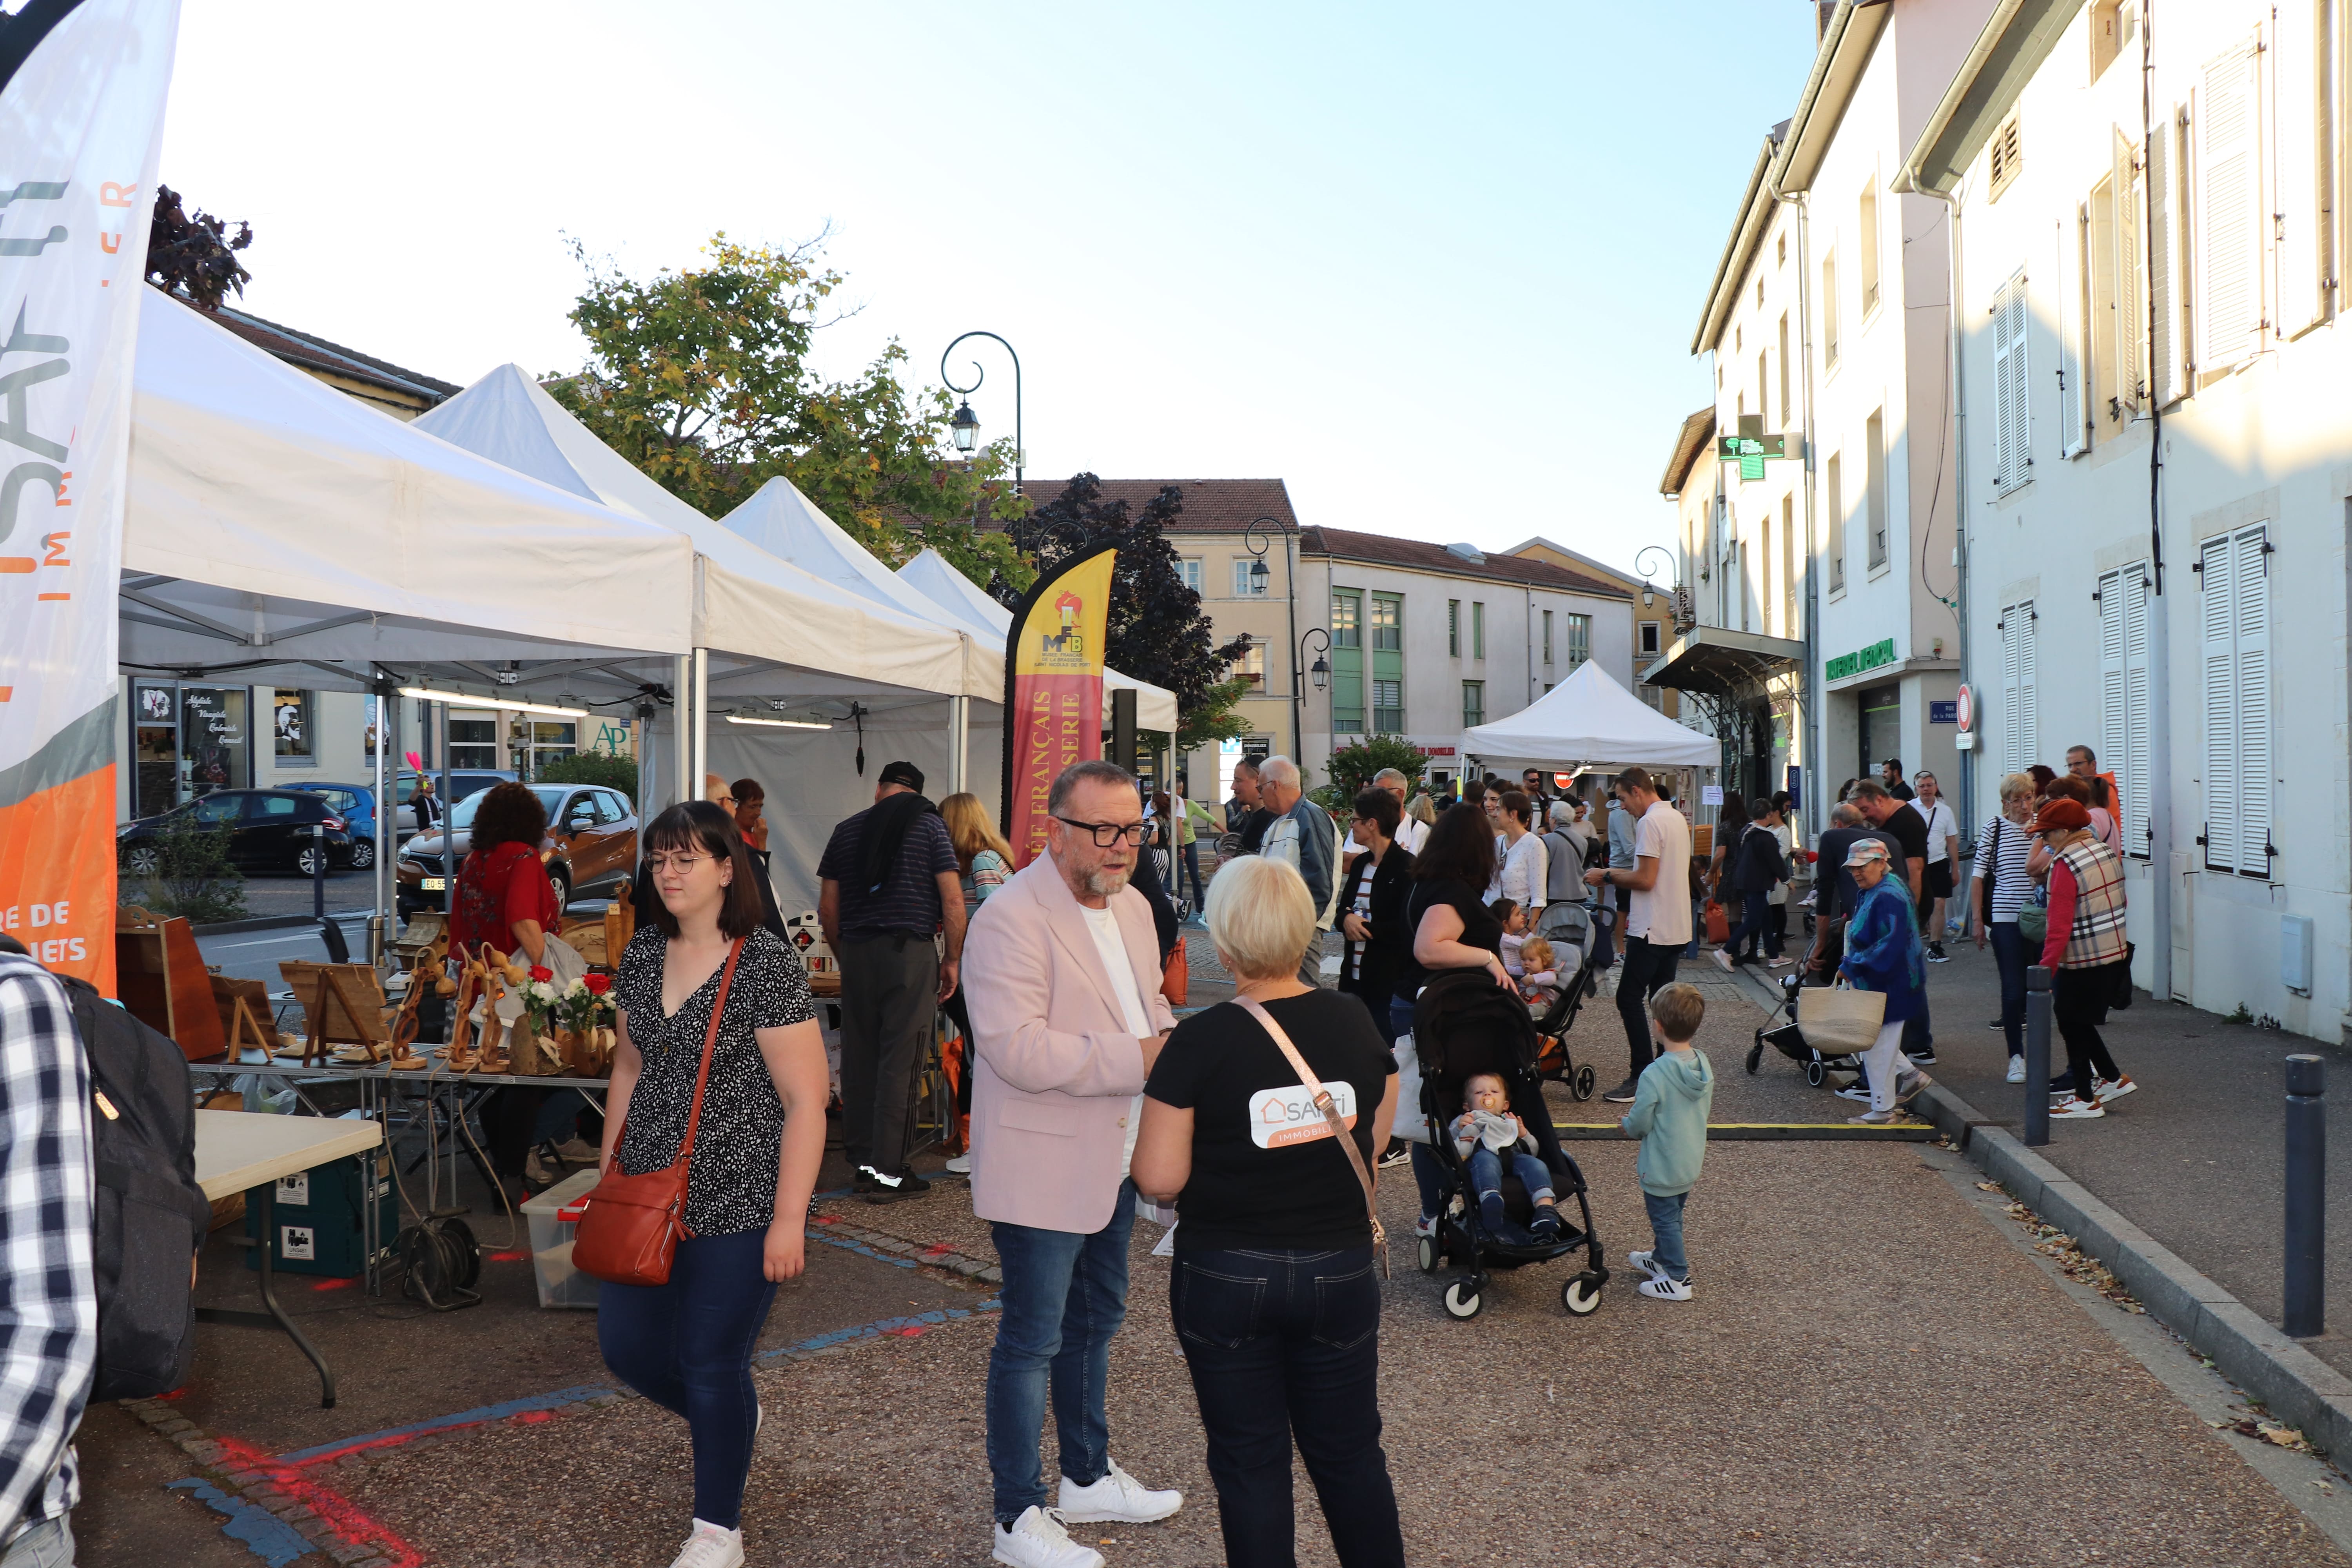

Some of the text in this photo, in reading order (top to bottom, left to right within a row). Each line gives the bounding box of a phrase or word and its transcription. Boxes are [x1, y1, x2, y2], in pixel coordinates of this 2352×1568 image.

[185, 695, 212, 708] Styliste
[198, 710, 227, 722] Visagiste
[209, 723, 238, 733] Coloriste
[591, 721, 626, 755] AP
[1060, 693, 1080, 768] SERIE
[1031, 691, 1054, 815] FRANÇAIS
[30, 901, 69, 927] DE
[1279, 1125, 1331, 1142] IMMOBILI
